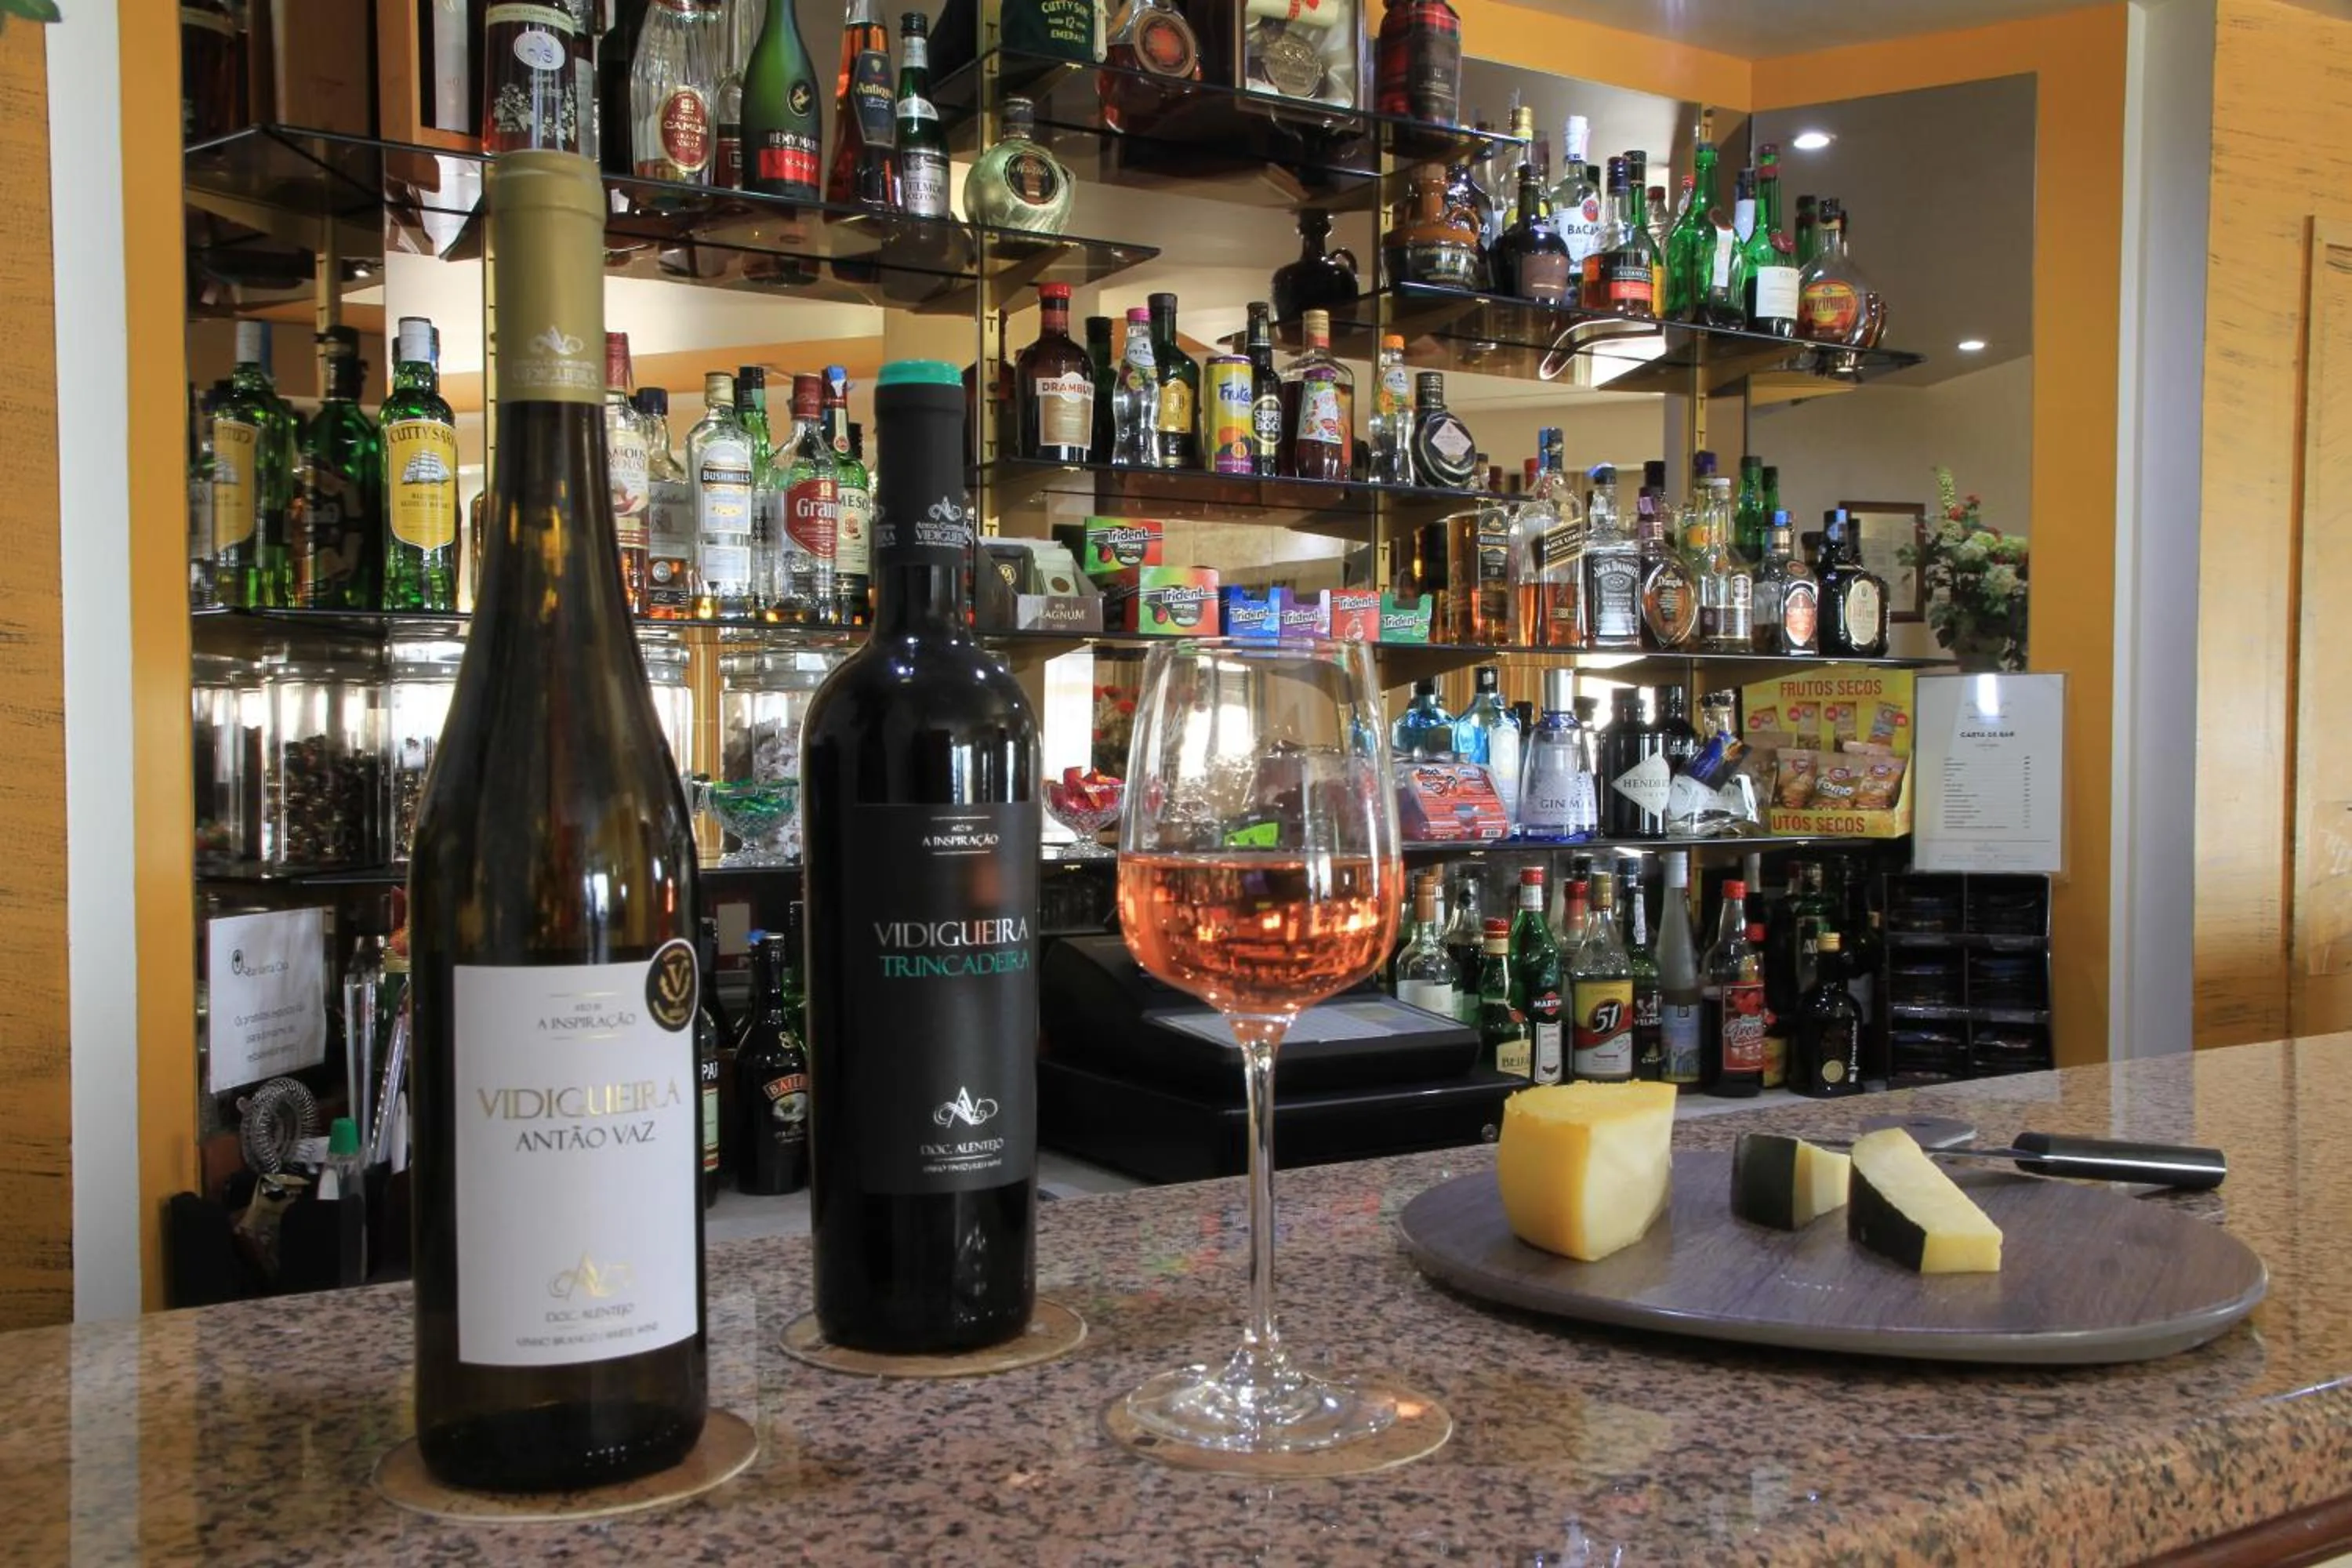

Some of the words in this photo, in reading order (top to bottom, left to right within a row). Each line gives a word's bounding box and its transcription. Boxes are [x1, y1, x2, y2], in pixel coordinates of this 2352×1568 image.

[390, 426, 431, 444] CUTTY
[1107, 527, 1150, 543] Trident
[1161, 586, 1205, 601] Trident
[1336, 596, 1374, 610] Trident
[1229, 607, 1270, 623] Trident
[1282, 610, 1320, 624] Trident
[1382, 615, 1419, 628] Trident
[1780, 681, 1834, 697] FRUTOS
[1837, 679, 1882, 696] SECOS
[1540, 798, 1566, 810] GIN
[1772, 815, 1812, 831] UTOS
[1817, 815, 1865, 833] SECOS
[923, 836, 931, 848] A
[933, 833, 999, 848] INSPIRAÇÃO
[873, 916, 1029, 949] VIDIGUEIRA
[878, 948, 1030, 978] TRINCADEIRA
[538, 1017, 548, 1031] A
[551, 1011, 637, 1030] INSPIRAÇÃO
[1592, 1003, 1620, 1033] 51
[477, 1077, 681, 1120] VIDIGUEIRA
[514, 1125, 606, 1152] ANTÃO
[612, 1120, 658, 1145] VAZ
[955, 1137, 1004, 1153] ALENTEJO
